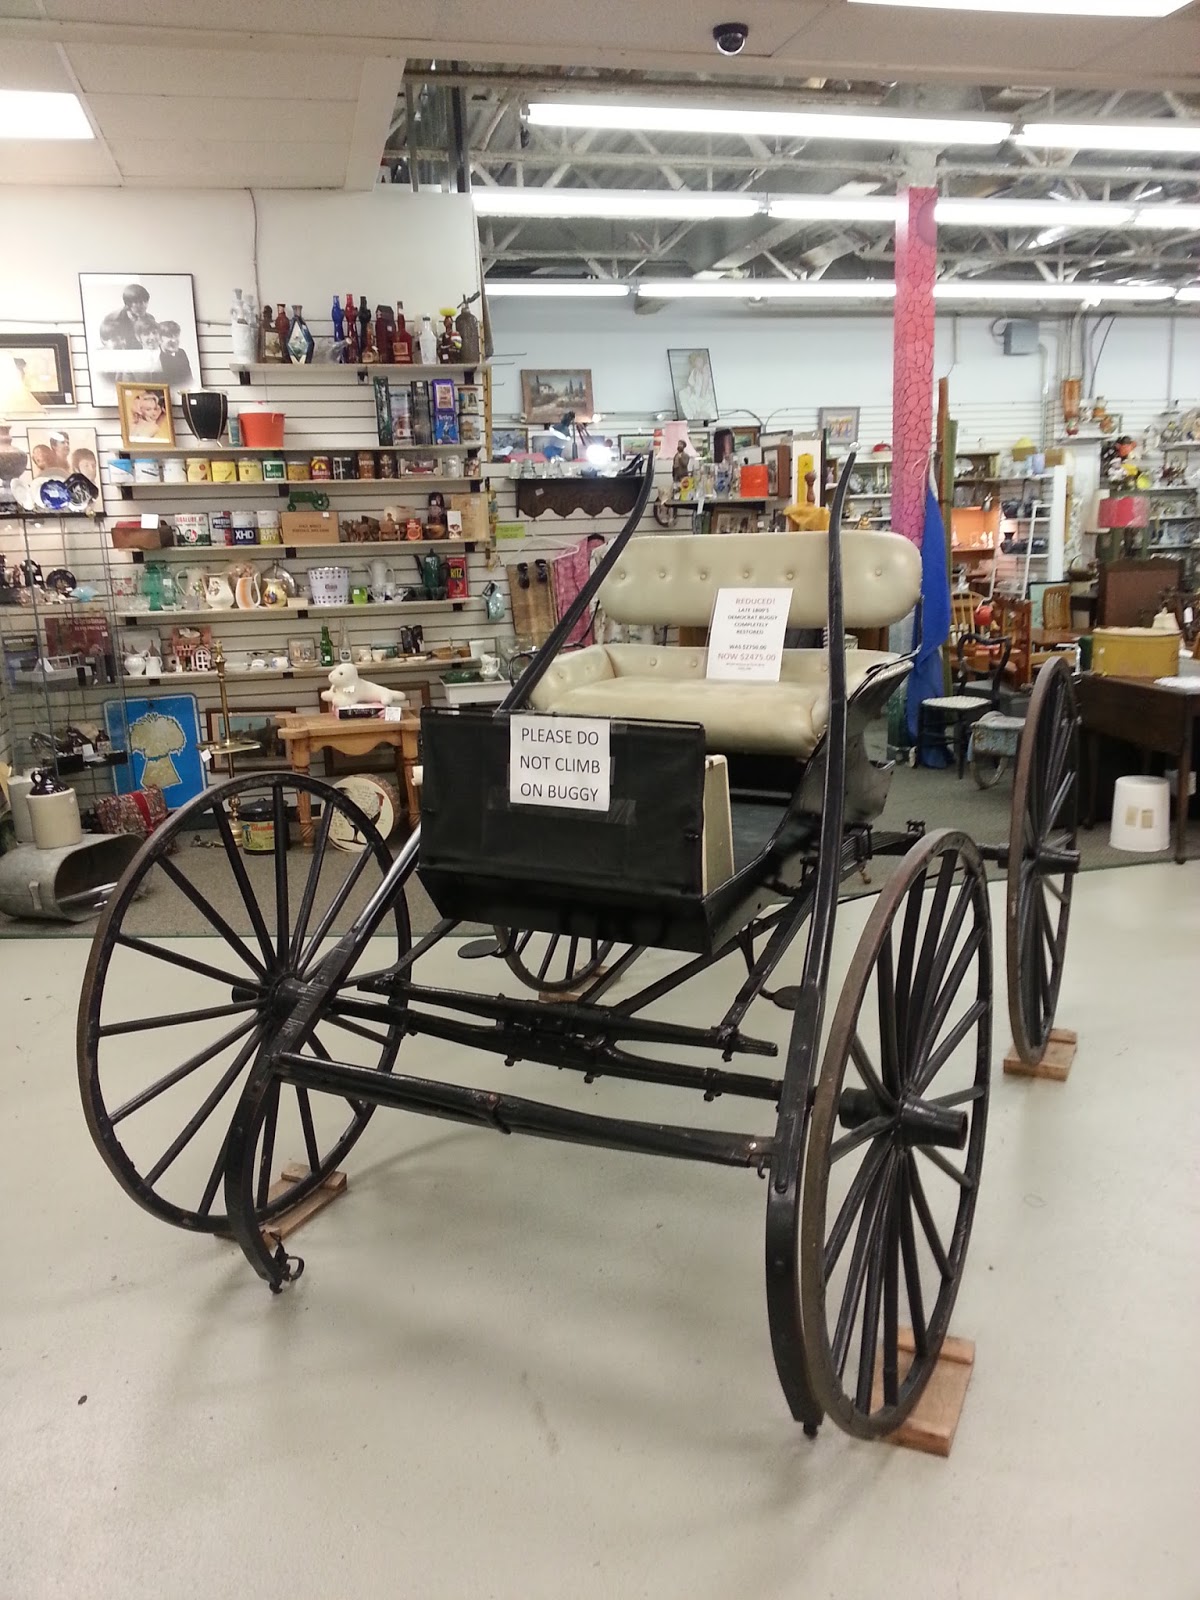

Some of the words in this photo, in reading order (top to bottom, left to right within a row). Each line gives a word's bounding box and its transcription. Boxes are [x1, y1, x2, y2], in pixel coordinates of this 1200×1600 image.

[235, 530, 254, 540] XHD
[450, 567, 463, 579] RITZ
[739, 653, 776, 661] $2475.00
[521, 728, 572, 744] PLEASE
[577, 731, 599, 745] DO
[520, 755, 551, 770] NOT
[555, 757, 600, 774] CLIMB
[520, 783, 543, 797] ON
[548, 785, 599, 802] BUGGY
